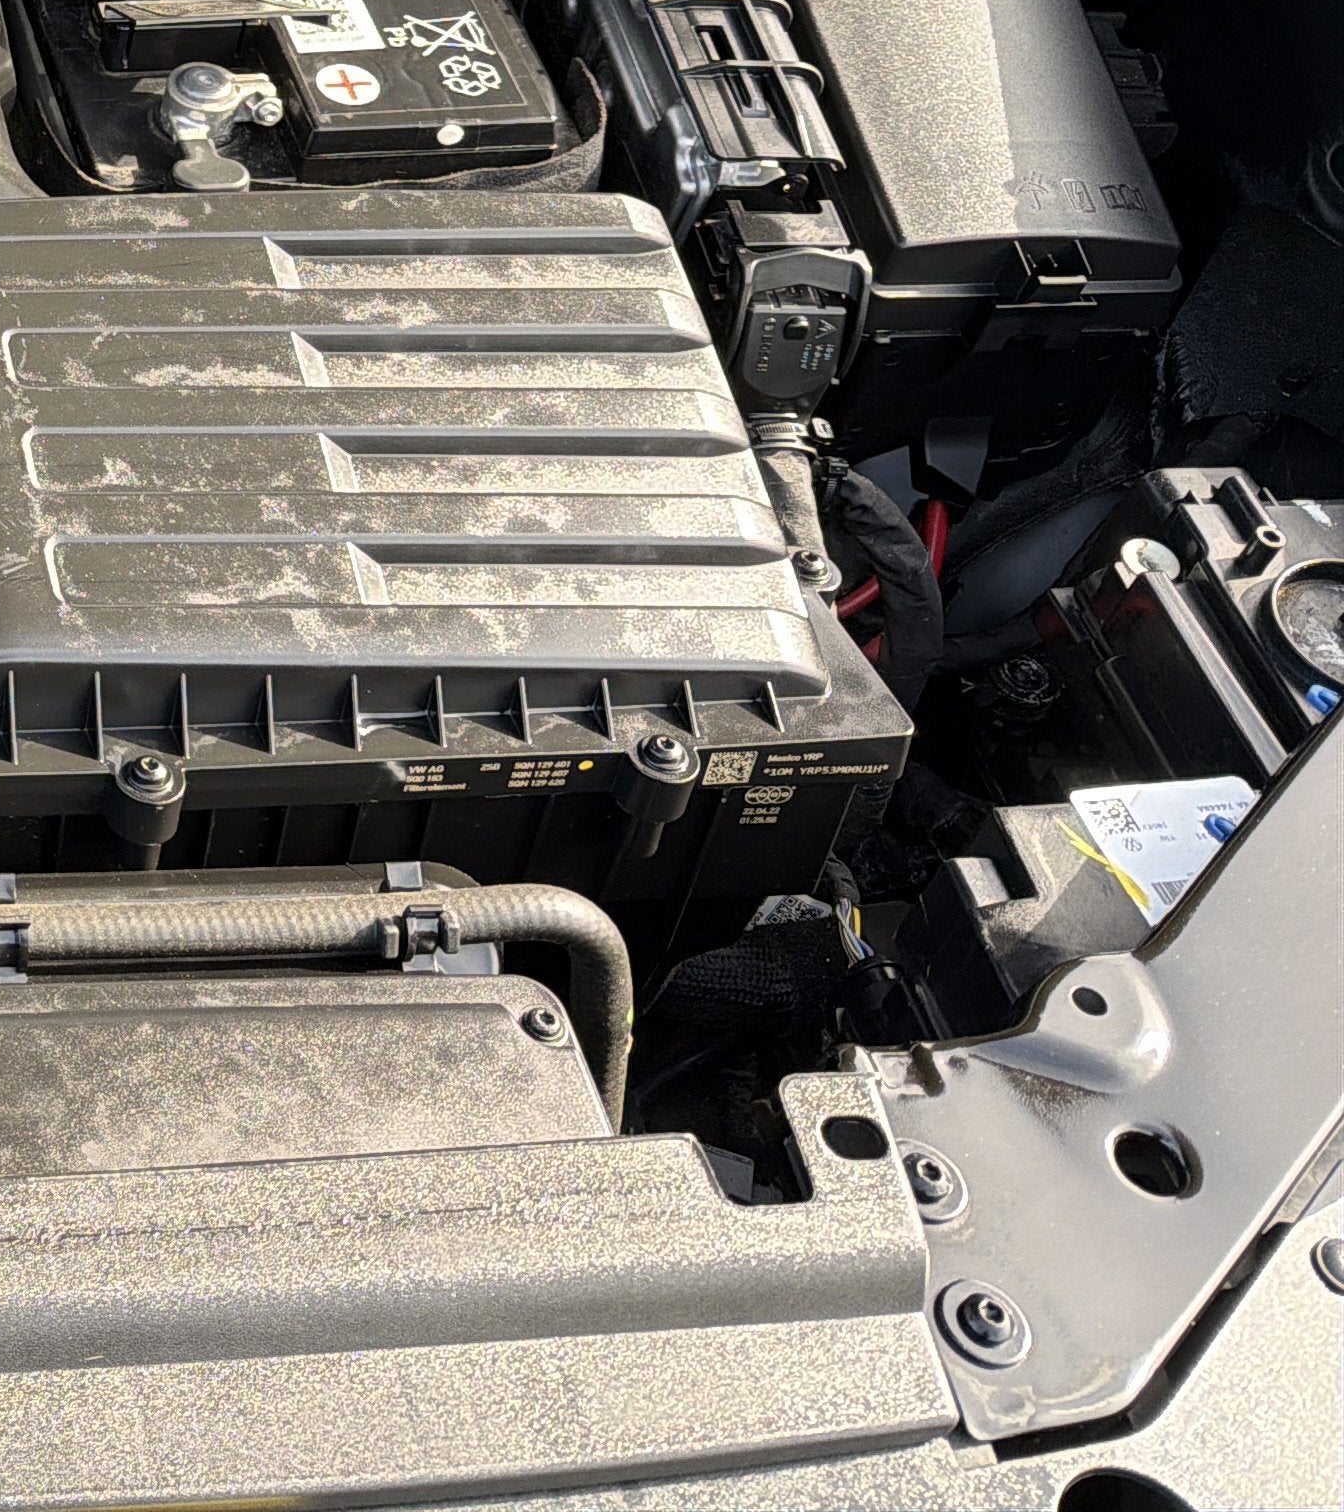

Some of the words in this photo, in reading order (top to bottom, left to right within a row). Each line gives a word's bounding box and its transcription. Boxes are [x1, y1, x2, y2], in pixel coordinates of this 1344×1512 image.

[382, 26, 410, 48] Pb
[767, 754, 802, 764] Mexico
[803, 752, 824, 761] YRP
[408, 766, 428, 774] VW
[428, 764, 445, 774] AG
[537, 760, 554, 769] 129
[533, 770, 551, 778] 129
[530, 779, 547, 787] 129
